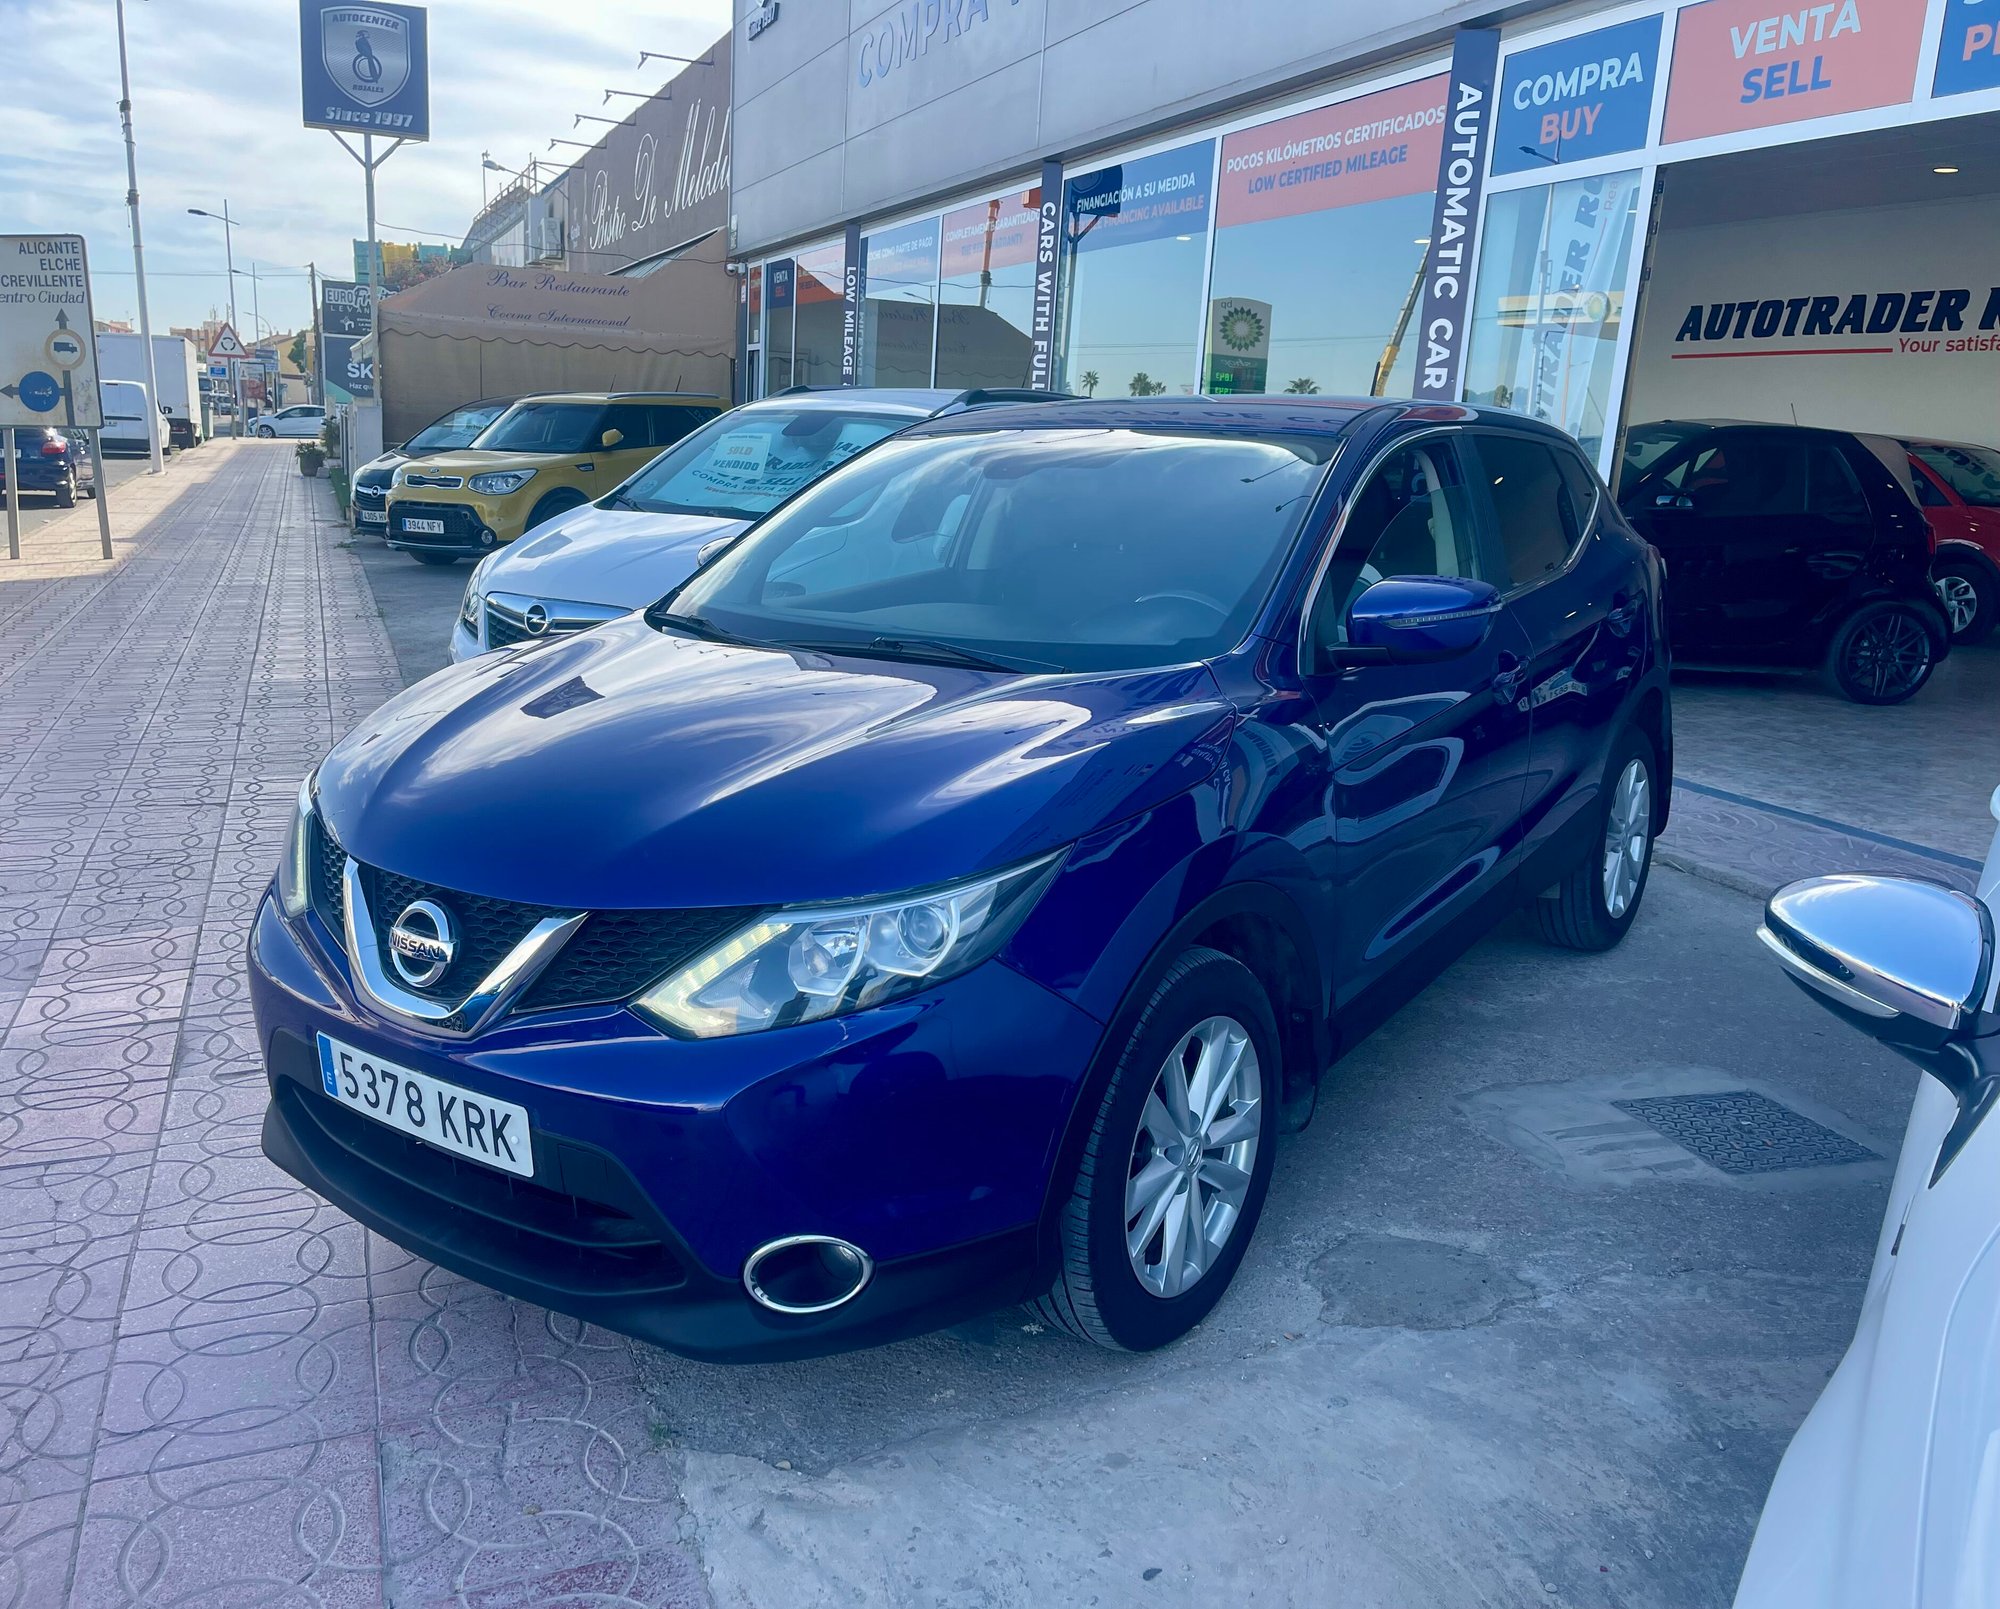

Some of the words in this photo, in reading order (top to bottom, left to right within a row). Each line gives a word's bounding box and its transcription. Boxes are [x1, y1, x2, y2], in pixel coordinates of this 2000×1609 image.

[332, 13, 400, 30] AUTOCENTER
[1729, 0, 1862, 59] VENTA
[1962, 20, 2000, 61] P
[1513, 52, 1644, 111] COMPRA
[1740, 55, 1832, 104] SELL
[325, 106, 371, 122] Since
[374, 111, 413, 127] 1997
[1539, 103, 1603, 145] BUY
[1227, 151, 1264, 174] POCOS
[1266, 131, 1342, 165] KILÓMETROS
[1344, 104, 1446, 146] CERTIFICADOS
[1248, 174, 1277, 194] LOW
[1278, 160, 1342, 188] CERTIFIED
[1346, 144, 1408, 175] MILEAGE
[590, 170, 626, 249] Bistro
[632, 133, 659, 231] De
[1076, 185, 1135, 213] FINANCIACIÓN
[1135, 188, 1142, 199] A
[1144, 181, 1156, 197] SU
[1157, 172, 1196, 194] MEDIDA
[1152, 194, 1205, 218] AVAILABLE
[1434, 82, 1483, 300] AUTOMATIC
[19, 241, 79, 254] ALICANTE
[1039, 201, 1056, 263] CARS
[0, 274, 84, 287] CREVILLENTE
[40, 257, 81, 271] ELCHE
[487, 269, 527, 289] Bar
[534, 273, 631, 297] Restaurante
[845, 266, 856, 303] LOW
[0, 291, 36, 303] entro
[38, 291, 85, 304] Ciudad
[330, 305, 371, 314] LEVAN
[487, 303, 532, 321] Cocina
[538, 310, 631, 327] Internacional
[1035, 271, 1052, 332] WITH
[1675, 288, 1971, 342] AUTOTRADER
[843, 310, 855, 375] MILEAGE
[1422, 317, 1454, 389] CAR
[1899, 337, 1941, 353] Your
[1031, 340, 1047, 390] FULL
[692, 470, 738, 489] COMPRA
[713, 459, 760, 471] VENDIDO
[407, 520, 425, 530] 3944
[427, 520, 441, 532] NFY
[390, 931, 441, 960] NISSAN
[327, 1072, 333, 1085] E
[340, 1051, 426, 1128] 5378
[437, 1090, 517, 1163] KRK
